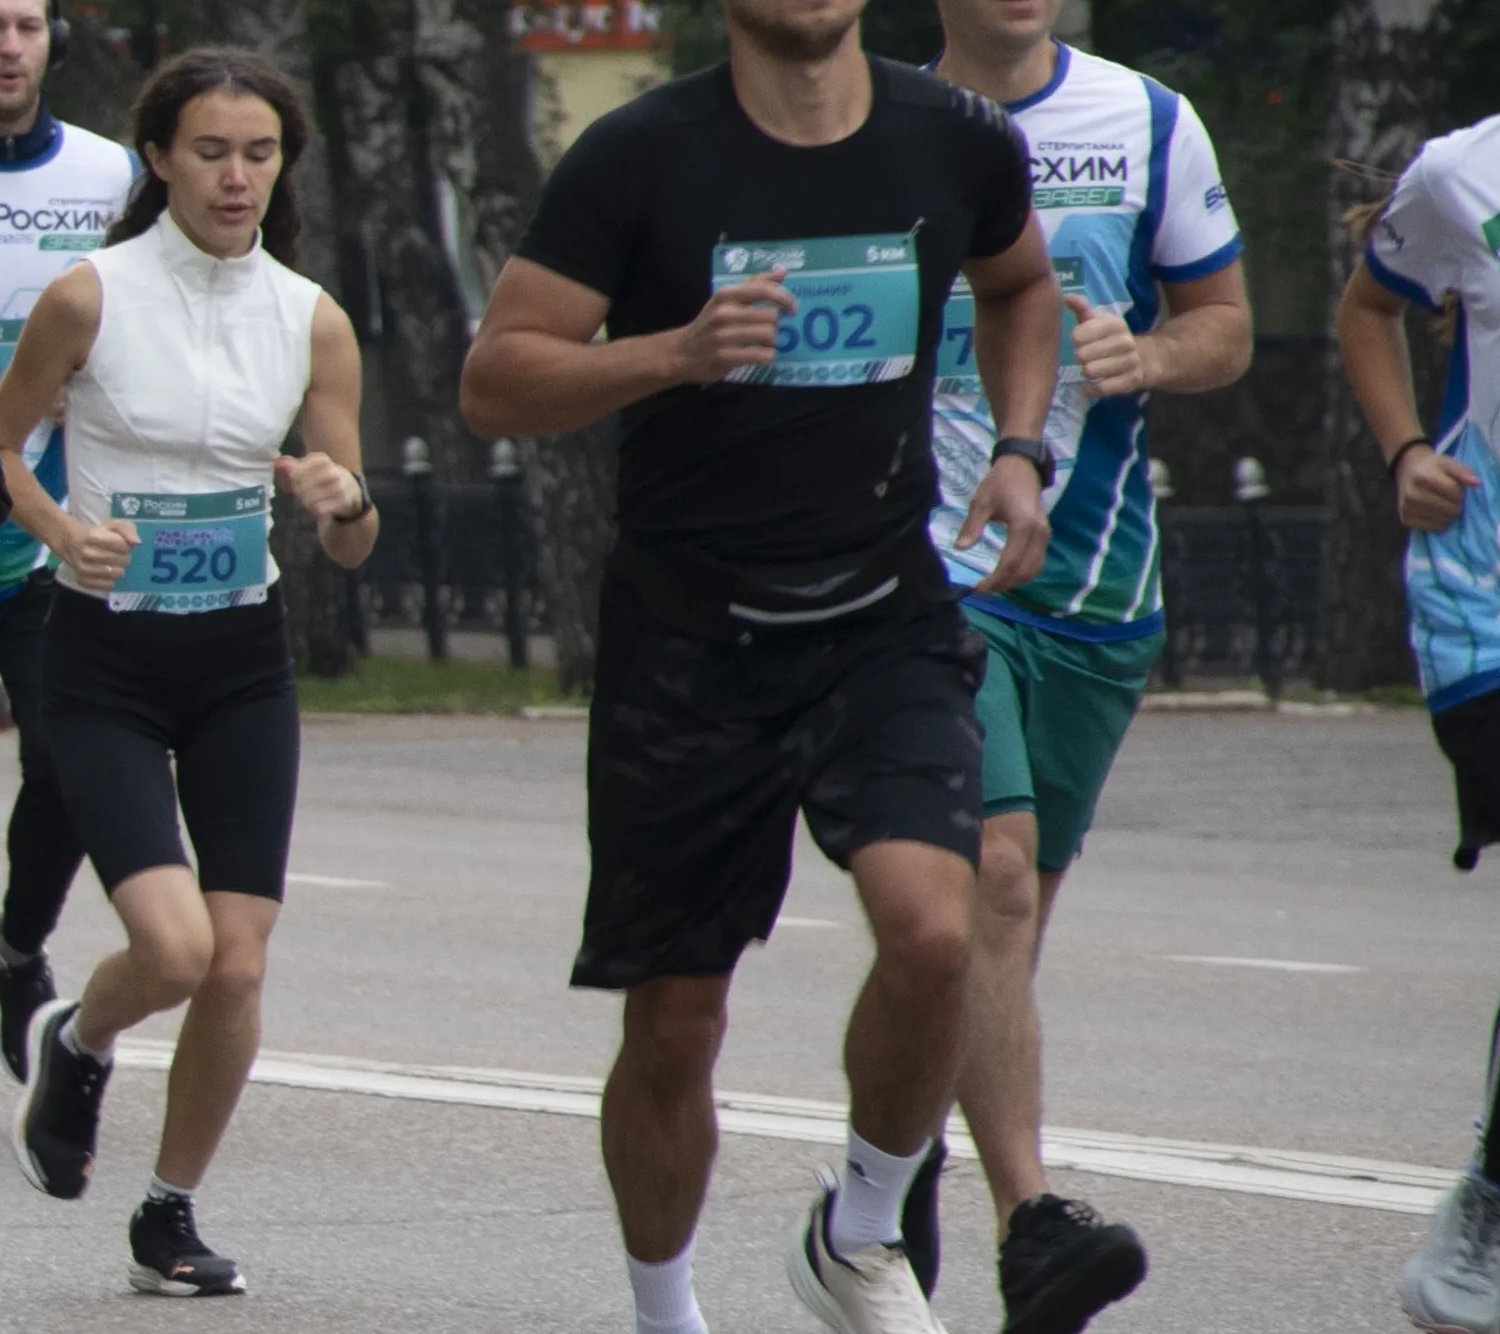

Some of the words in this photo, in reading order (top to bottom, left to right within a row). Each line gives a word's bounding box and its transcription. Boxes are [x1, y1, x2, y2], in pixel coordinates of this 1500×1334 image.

[1037, 141, 1126, 151] СТЕРЛИТАМАК
[1034, 189, 1122, 207] ЗАБЕГ
[150, 545, 238, 585] 520
